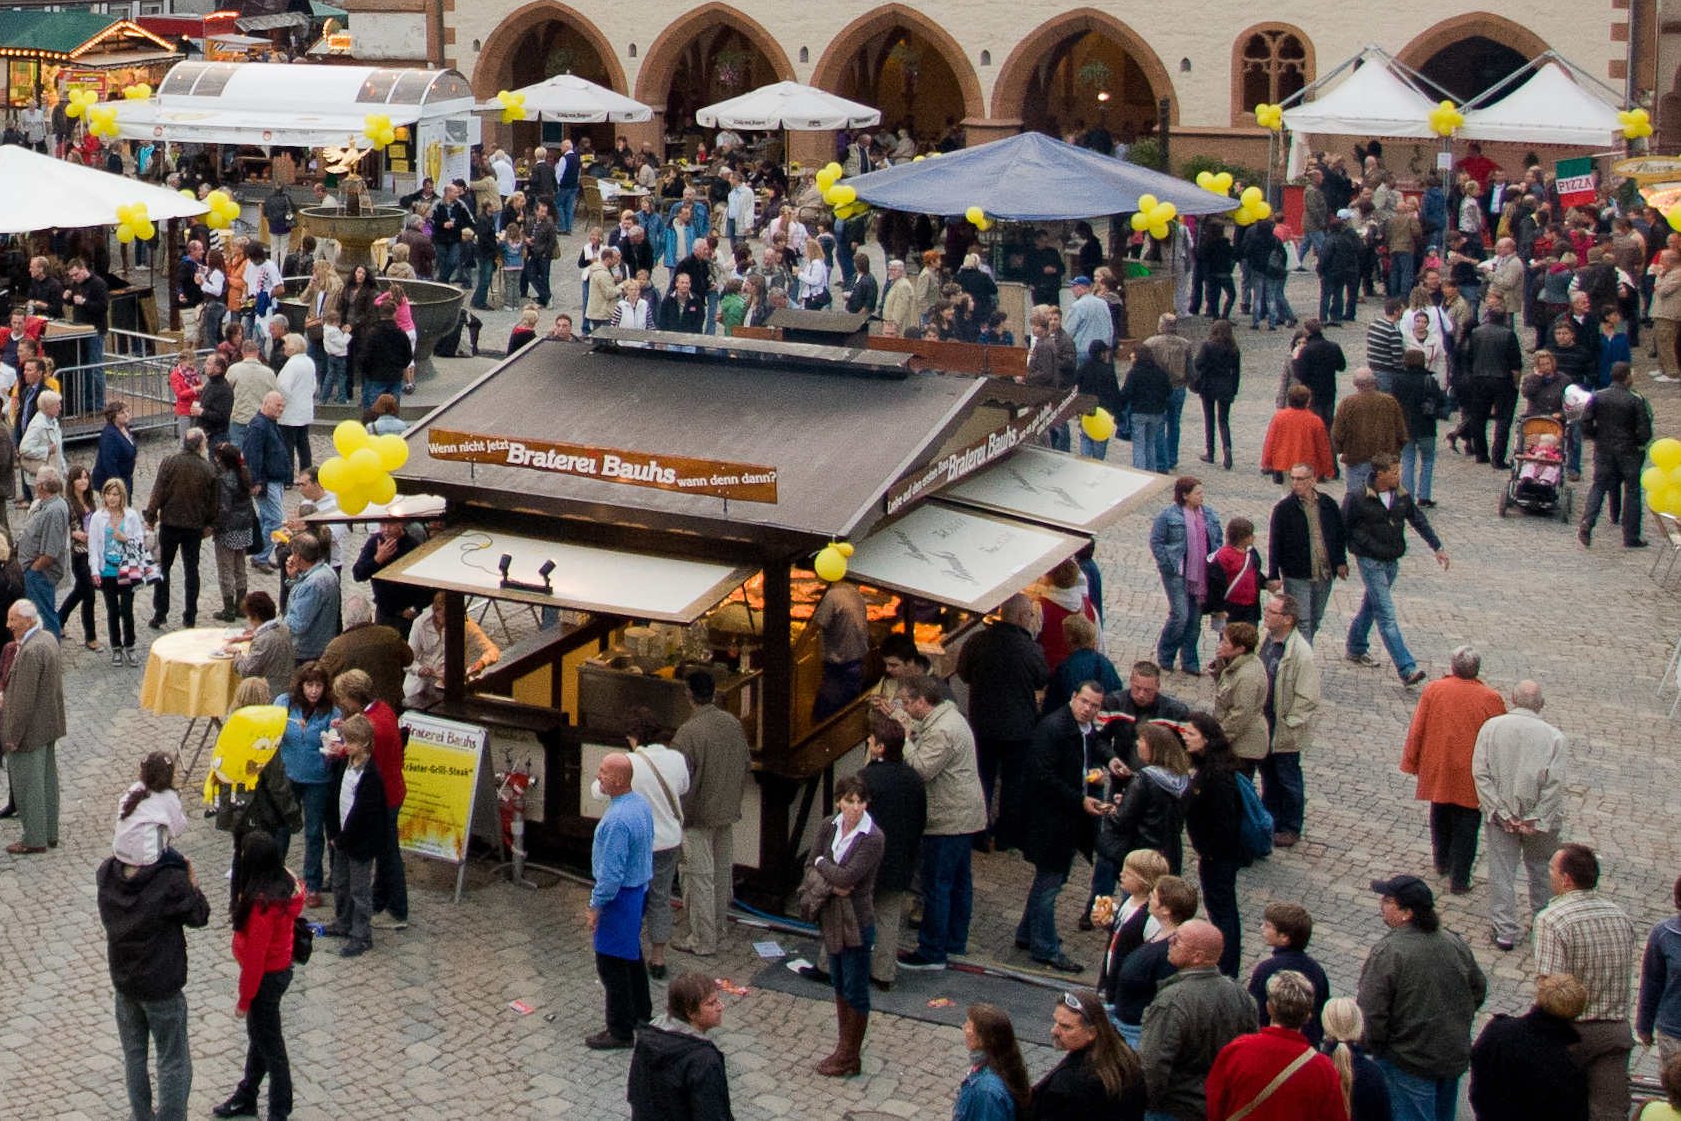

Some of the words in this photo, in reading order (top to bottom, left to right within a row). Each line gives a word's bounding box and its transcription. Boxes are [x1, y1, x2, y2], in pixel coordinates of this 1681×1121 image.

[1558, 177, 1593, 192] PIZZA
[428, 443, 457, 454] Wenn
[459, 440, 486, 452] nicht
[486, 439, 510, 454] jetzt
[506, 442, 597, 475] Braterei
[601, 454, 676, 484] Bauhs
[676, 478, 708, 487] wann
[709, 473, 739, 486] denn
[741, 471, 778, 484] dann?
[947, 439, 987, 483] Braterei
[987, 425, 1017, 459] Bauhs
[406, 723, 445, 743] Braterei
[446, 731, 477, 749] Bauhs
